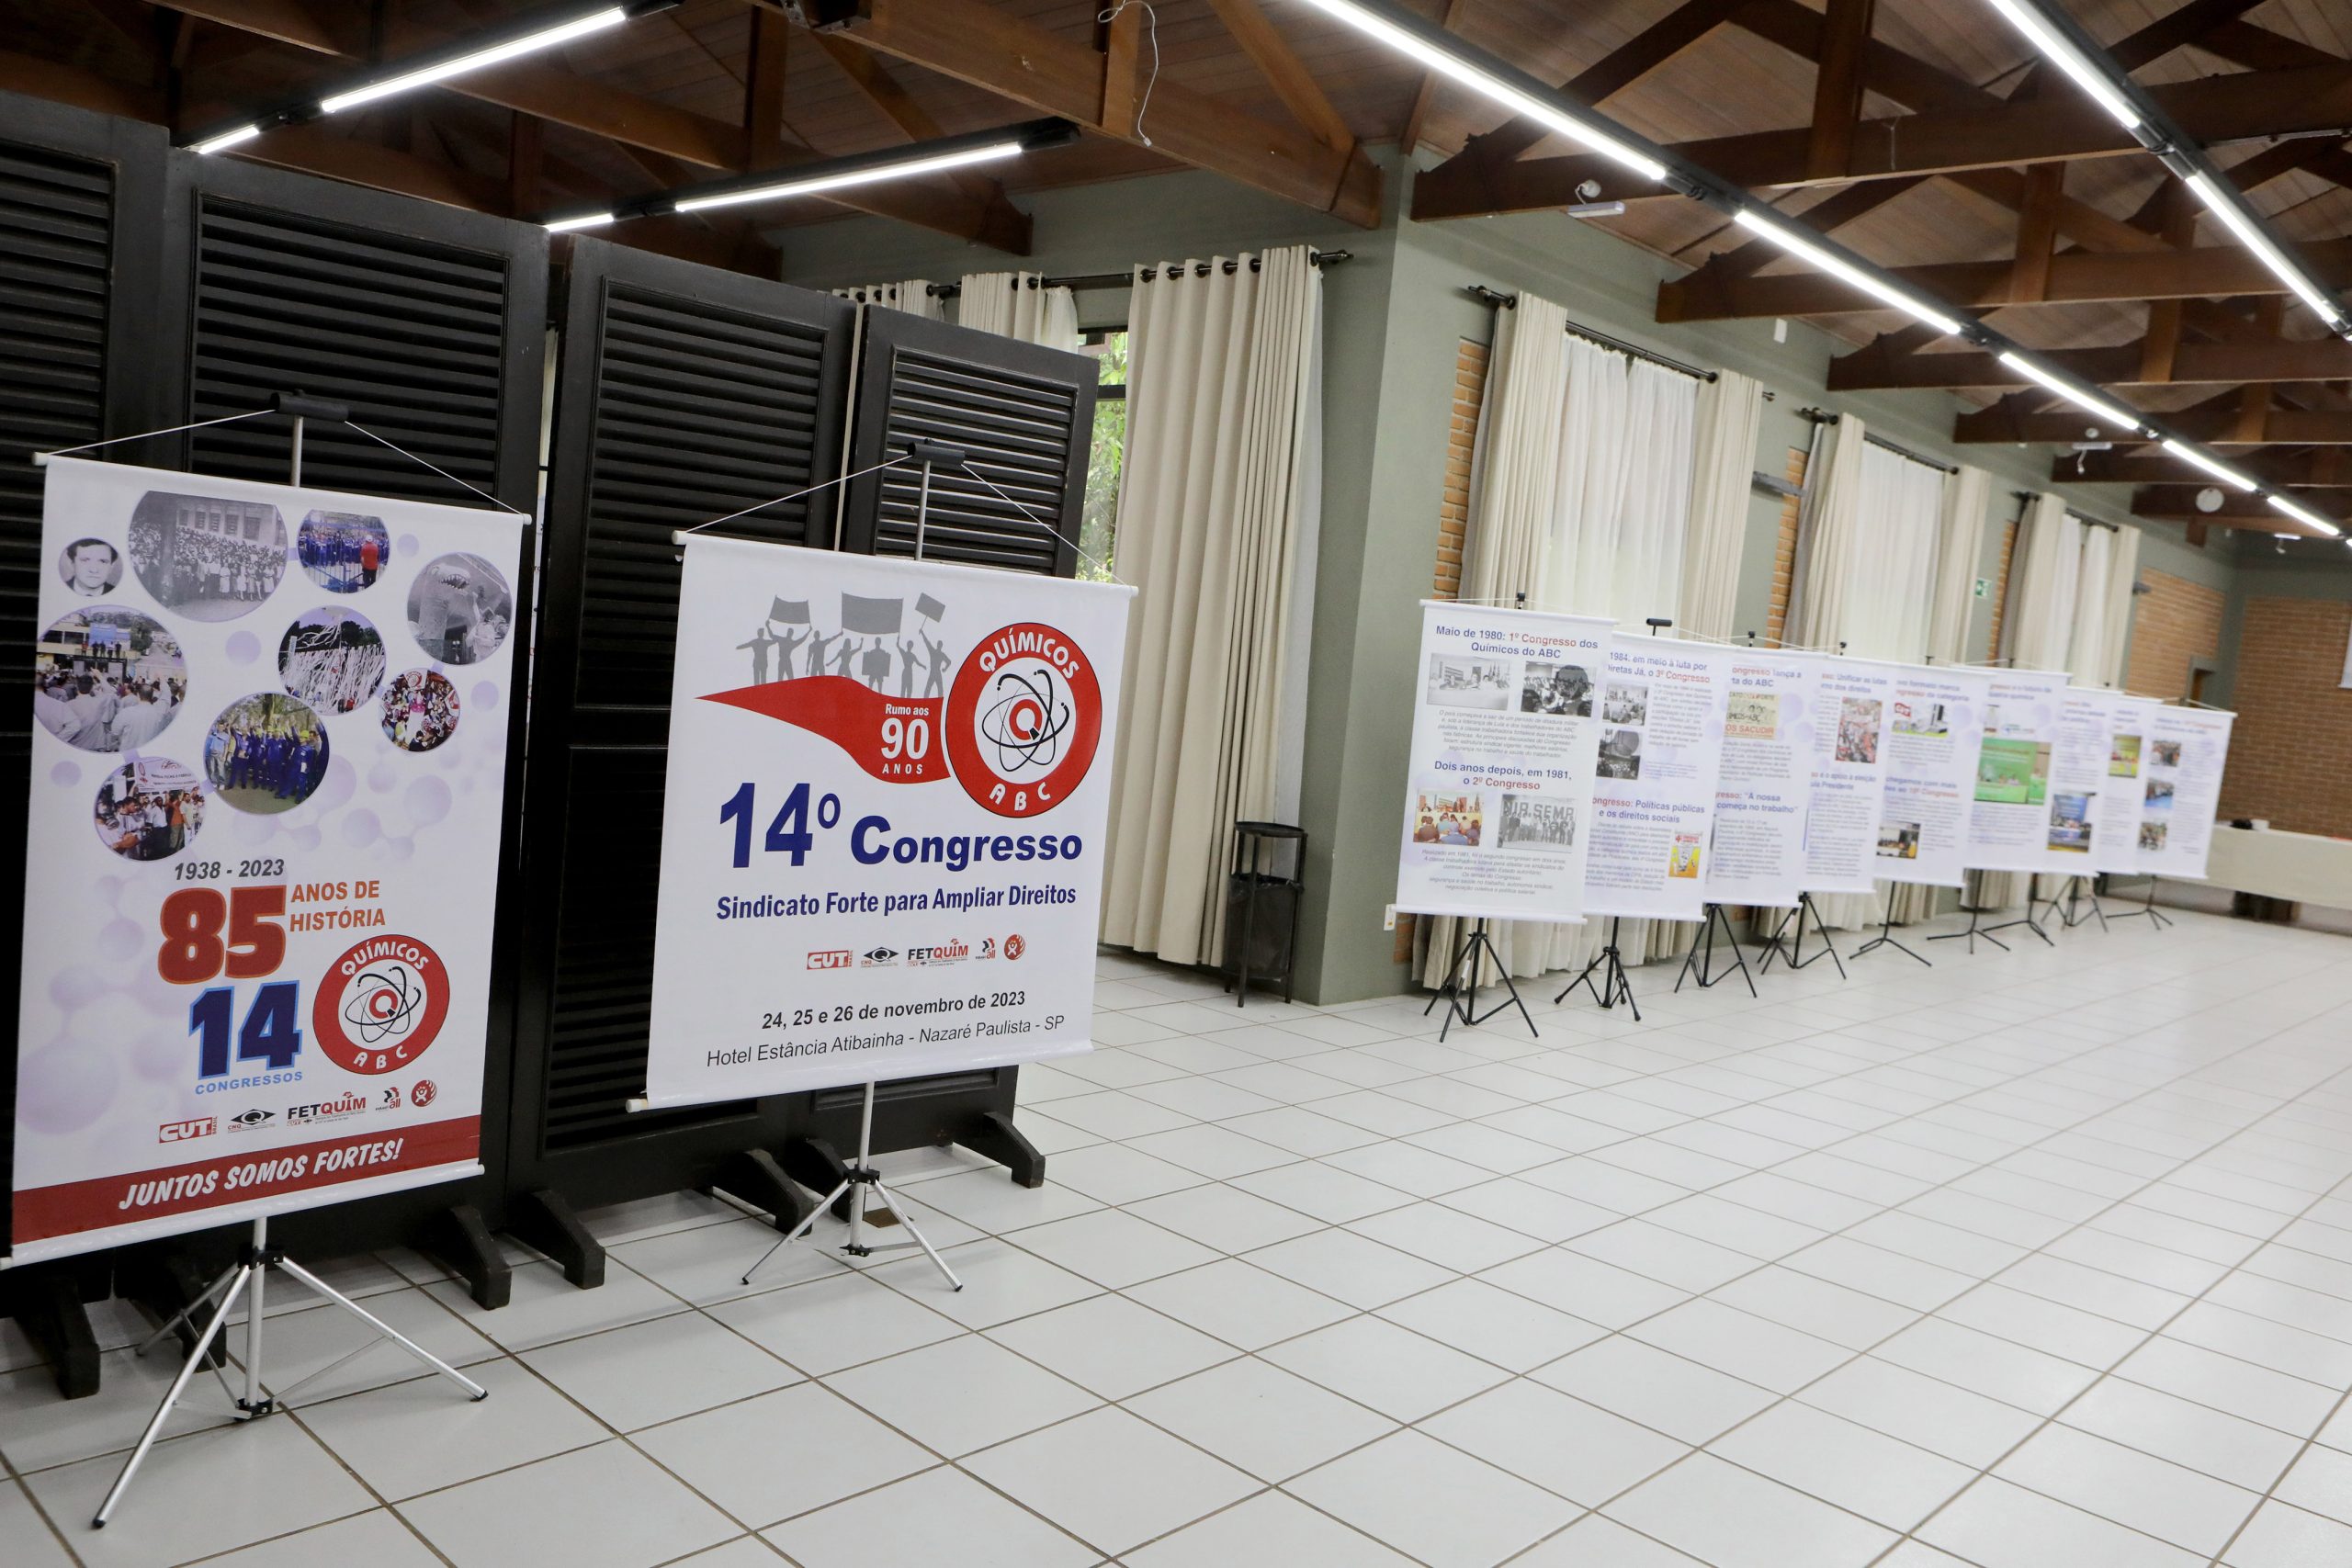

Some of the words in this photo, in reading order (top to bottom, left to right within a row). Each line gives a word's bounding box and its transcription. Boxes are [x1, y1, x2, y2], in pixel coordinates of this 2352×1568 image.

[1436, 626, 1461, 637] Maio
[1464, 628, 1476, 637] de
[1479, 630, 1506, 641] 1980:
[1521, 633, 1577, 648] Congresso
[1579, 638, 1599, 649] dos
[979, 627, 1080, 679] QUÍMICOS
[1471, 642, 1519, 655] Químicos
[1522, 647, 1535, 656] do
[1538, 648, 1561, 659] ABC
[1633, 656, 1645, 664] em
[1646, 657, 1667, 666] meio
[1676, 660, 1690, 669] luta
[1692, 662, 1707, 671] por
[1732, 666, 1770, 677] ongresso
[1666, 671, 1710, 683] Congresso
[1742, 678, 1753, 686] do
[1755, 678, 1774, 687] ABC
[885, 704, 911, 716] Rumo
[912, 706, 930, 716] aos
[880, 717, 930, 760] 90
[882, 764, 923, 774] ANOS
[1434, 761, 1457, 772] Dois
[1460, 764, 1485, 773] anos
[1487, 765, 1524, 777] depois,
[1527, 769, 1543, 777] em
[1486, 777, 1540, 790] Congresso
[1592, 796, 1634, 807] ongresso:
[1635, 799, 1669, 810] Políticas
[1672, 803, 1705, 813] públicas
[1717, 802, 1747, 812] começa
[1757, 794, 1781, 802] nossa
[1619, 810, 1649, 820] direitos
[1651, 814, 1679, 823] sociais
[851, 815, 1082, 872] Congresso
[174, 861, 221, 880] 1938
[239, 859, 285, 877] 2023
[290, 883, 347, 903] ANOS
[355, 880, 380, 898] DE
[717, 893, 820, 919] Sindicato
[826, 891, 878, 914] Forte
[884, 893, 928, 917] para
[933, 886, 1004, 912] Ampliar
[1009, 884, 1077, 906] Direitos
[289, 906, 386, 932] HISTÓRIA
[158, 886, 287, 985] 85
[341, 941, 429, 976] QUÍMICOS
[807, 950, 849, 970] CUT
[908, 943, 968, 961] FETQUIM
[762, 1012, 787, 1030] 24,
[793, 1010, 813, 1027] 25
[819, 1011, 829, 1024] e
[833, 1006, 854, 1022] 26
[858, 1004, 879, 1021] de
[884, 998, 965, 1018] novembro
[968, 995, 986, 1010] de
[990, 990, 1026, 1009] 2023
[188, 980, 303, 1080] 14
[707, 1045, 752, 1067] Hotel
[758, 1040, 828, 1062] Estância
[831, 1032, 904, 1053] Atibainha
[920, 1023, 971, 1043] Nazaré
[976, 1017, 1031, 1038] Paulista
[1045, 1015, 1065, 1031] SP
[195, 1071, 303, 1095] CONGRESSOS
[288, 1095, 366, 1119] FETQUIM
[160, 1117, 212, 1143] CUT
[119, 1170, 219, 1210] JUNTOS
[224, 1155, 308, 1190] SOMOS
[313, 1137, 404, 1174] FORTES!
